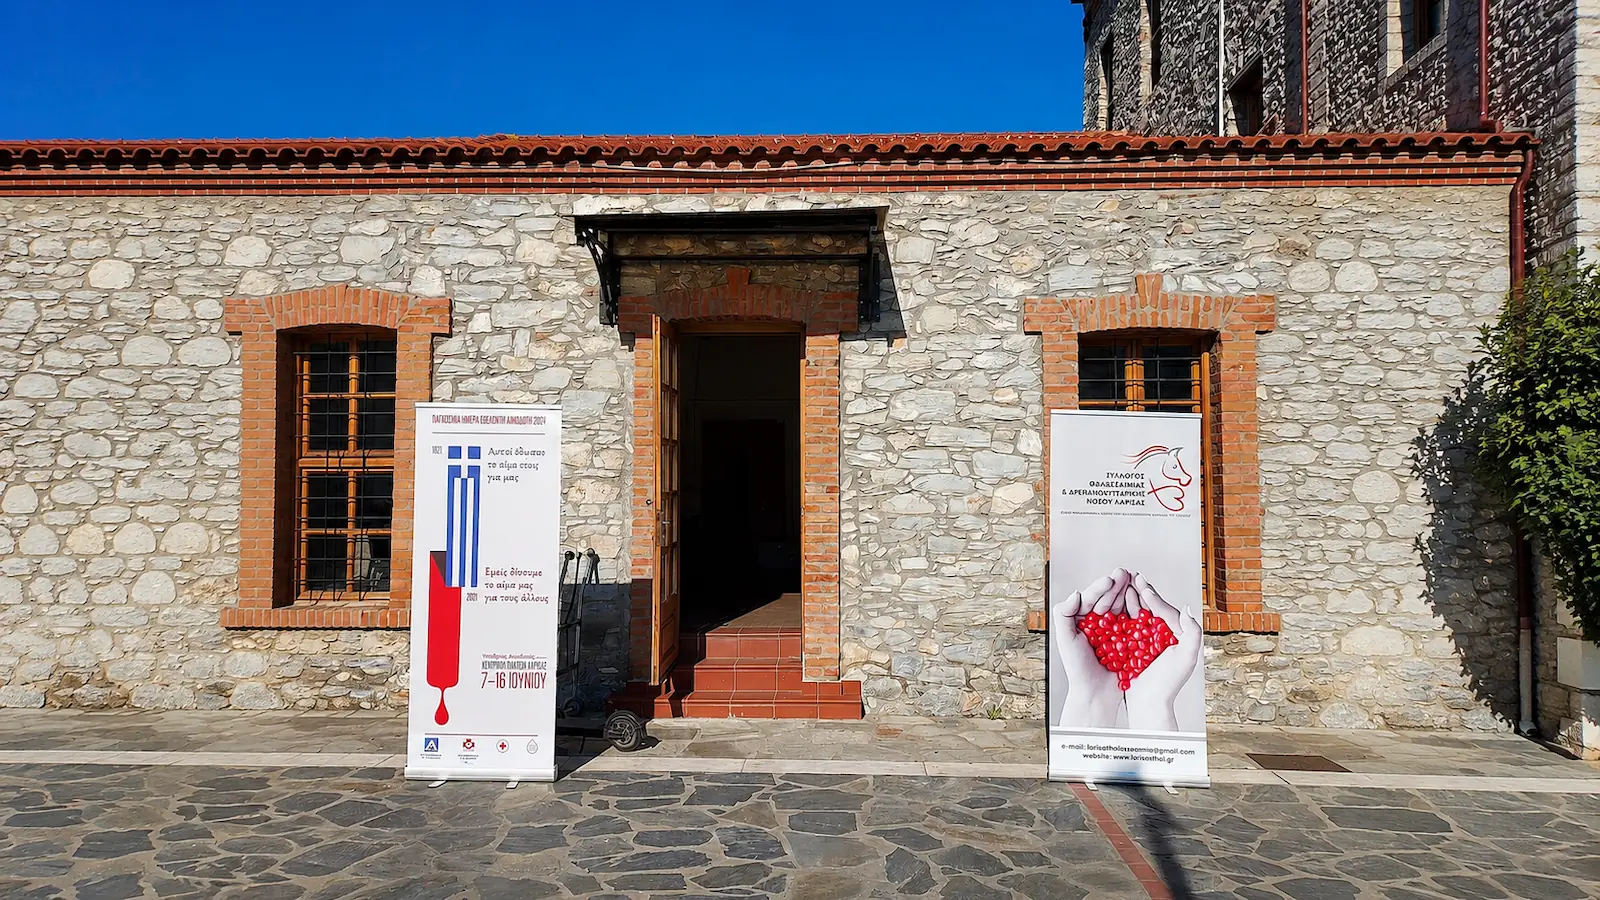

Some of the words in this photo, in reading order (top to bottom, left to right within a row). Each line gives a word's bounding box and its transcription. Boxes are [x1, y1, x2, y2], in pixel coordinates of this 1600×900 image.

[432, 446, 442, 454] 1821
[488, 447, 513, 456] Αυτοί
[498, 461, 518, 471] αίμα
[487, 475, 502, 484] για
[503, 475, 520, 484] μας
[1106, 472, 1145, 480] ΣΥΛΛΟΓΟΣ
[485, 567, 508, 578] Εμείς
[496, 580, 516, 590] αίμα
[466, 592, 478, 602] 2021
[484, 595, 498, 604] για
[500, 596, 518, 604] τους
[520, 593, 549, 604] άλλους
[508, 671, 547, 689] ΙΟΥΝΙΟΥ
